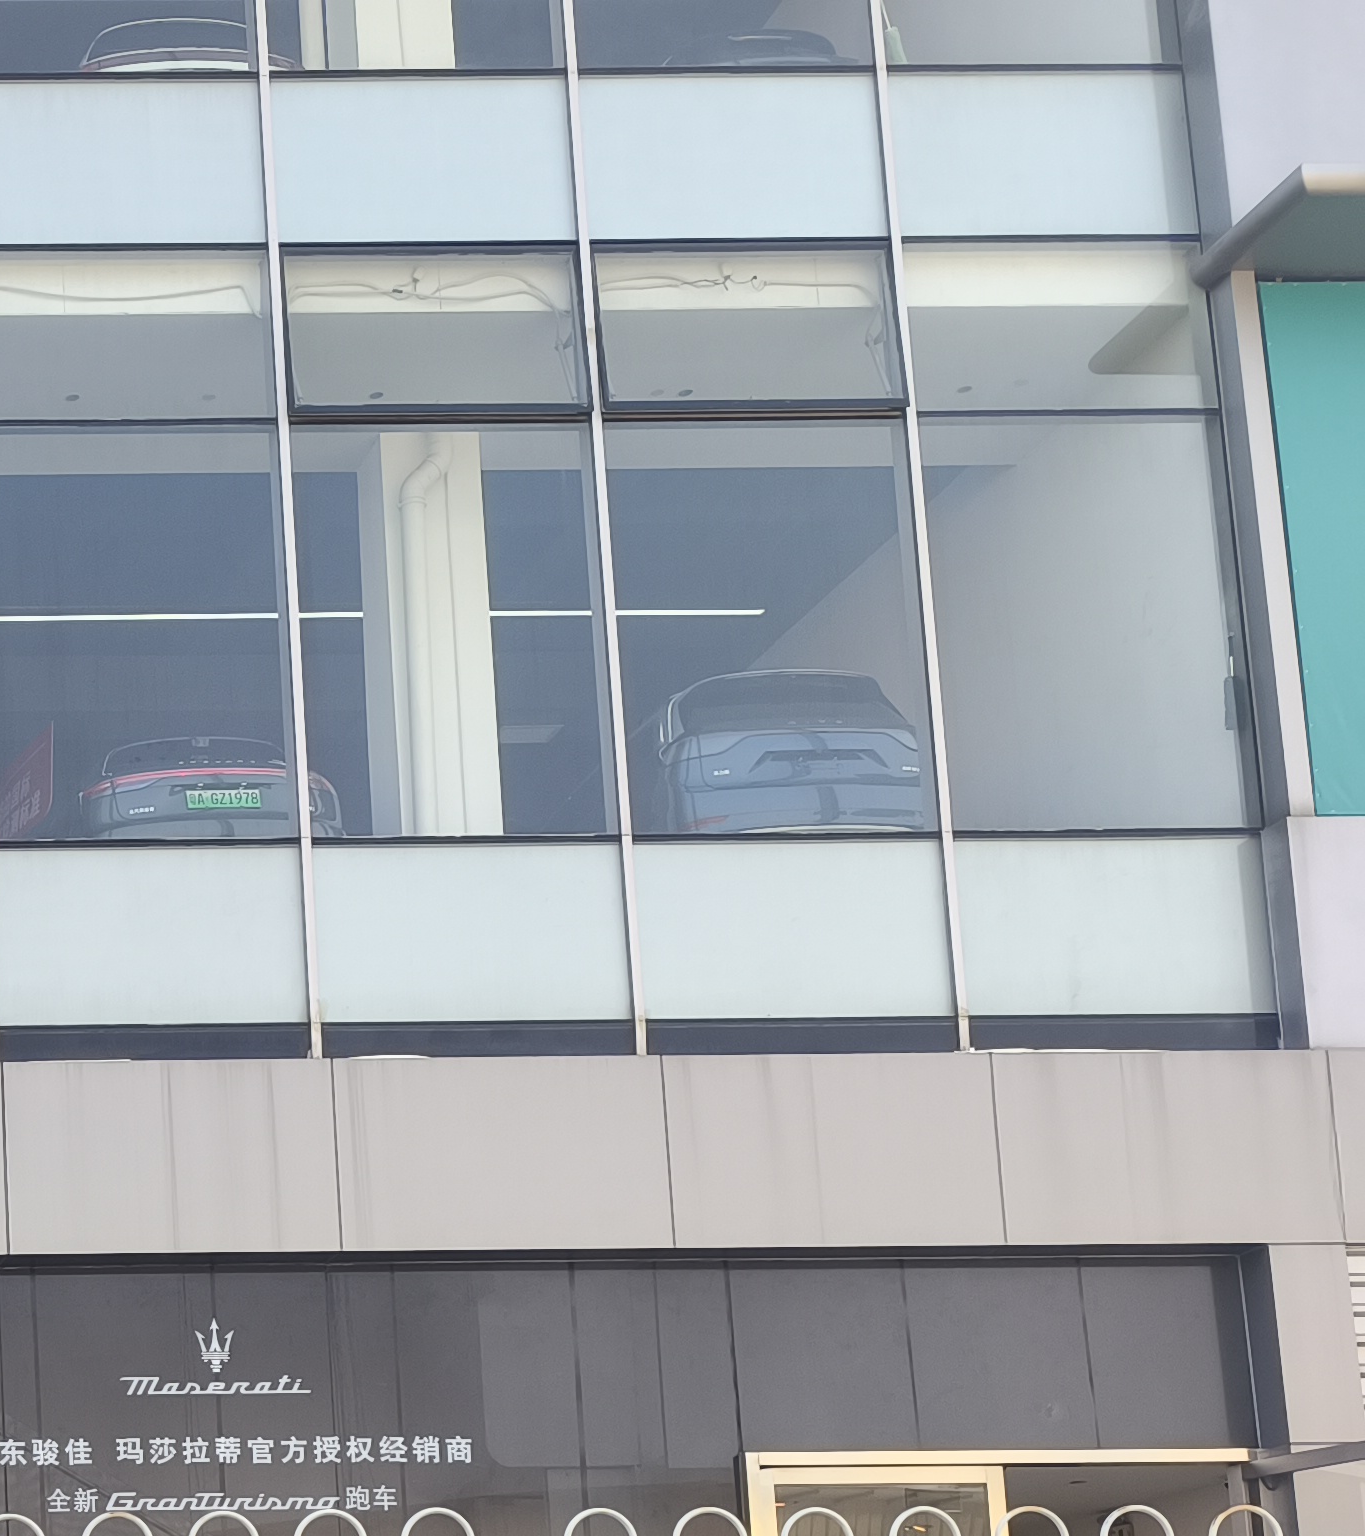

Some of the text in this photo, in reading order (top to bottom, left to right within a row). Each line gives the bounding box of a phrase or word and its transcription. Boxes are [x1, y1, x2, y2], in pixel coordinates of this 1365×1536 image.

[119, 1374, 311, 1396] Maserati
[115, 1435, 473, 1465] 玛莎拉蒂官方授权经销商
[47, 1485, 398, 1513] 全新 GranTurismo 跑车
